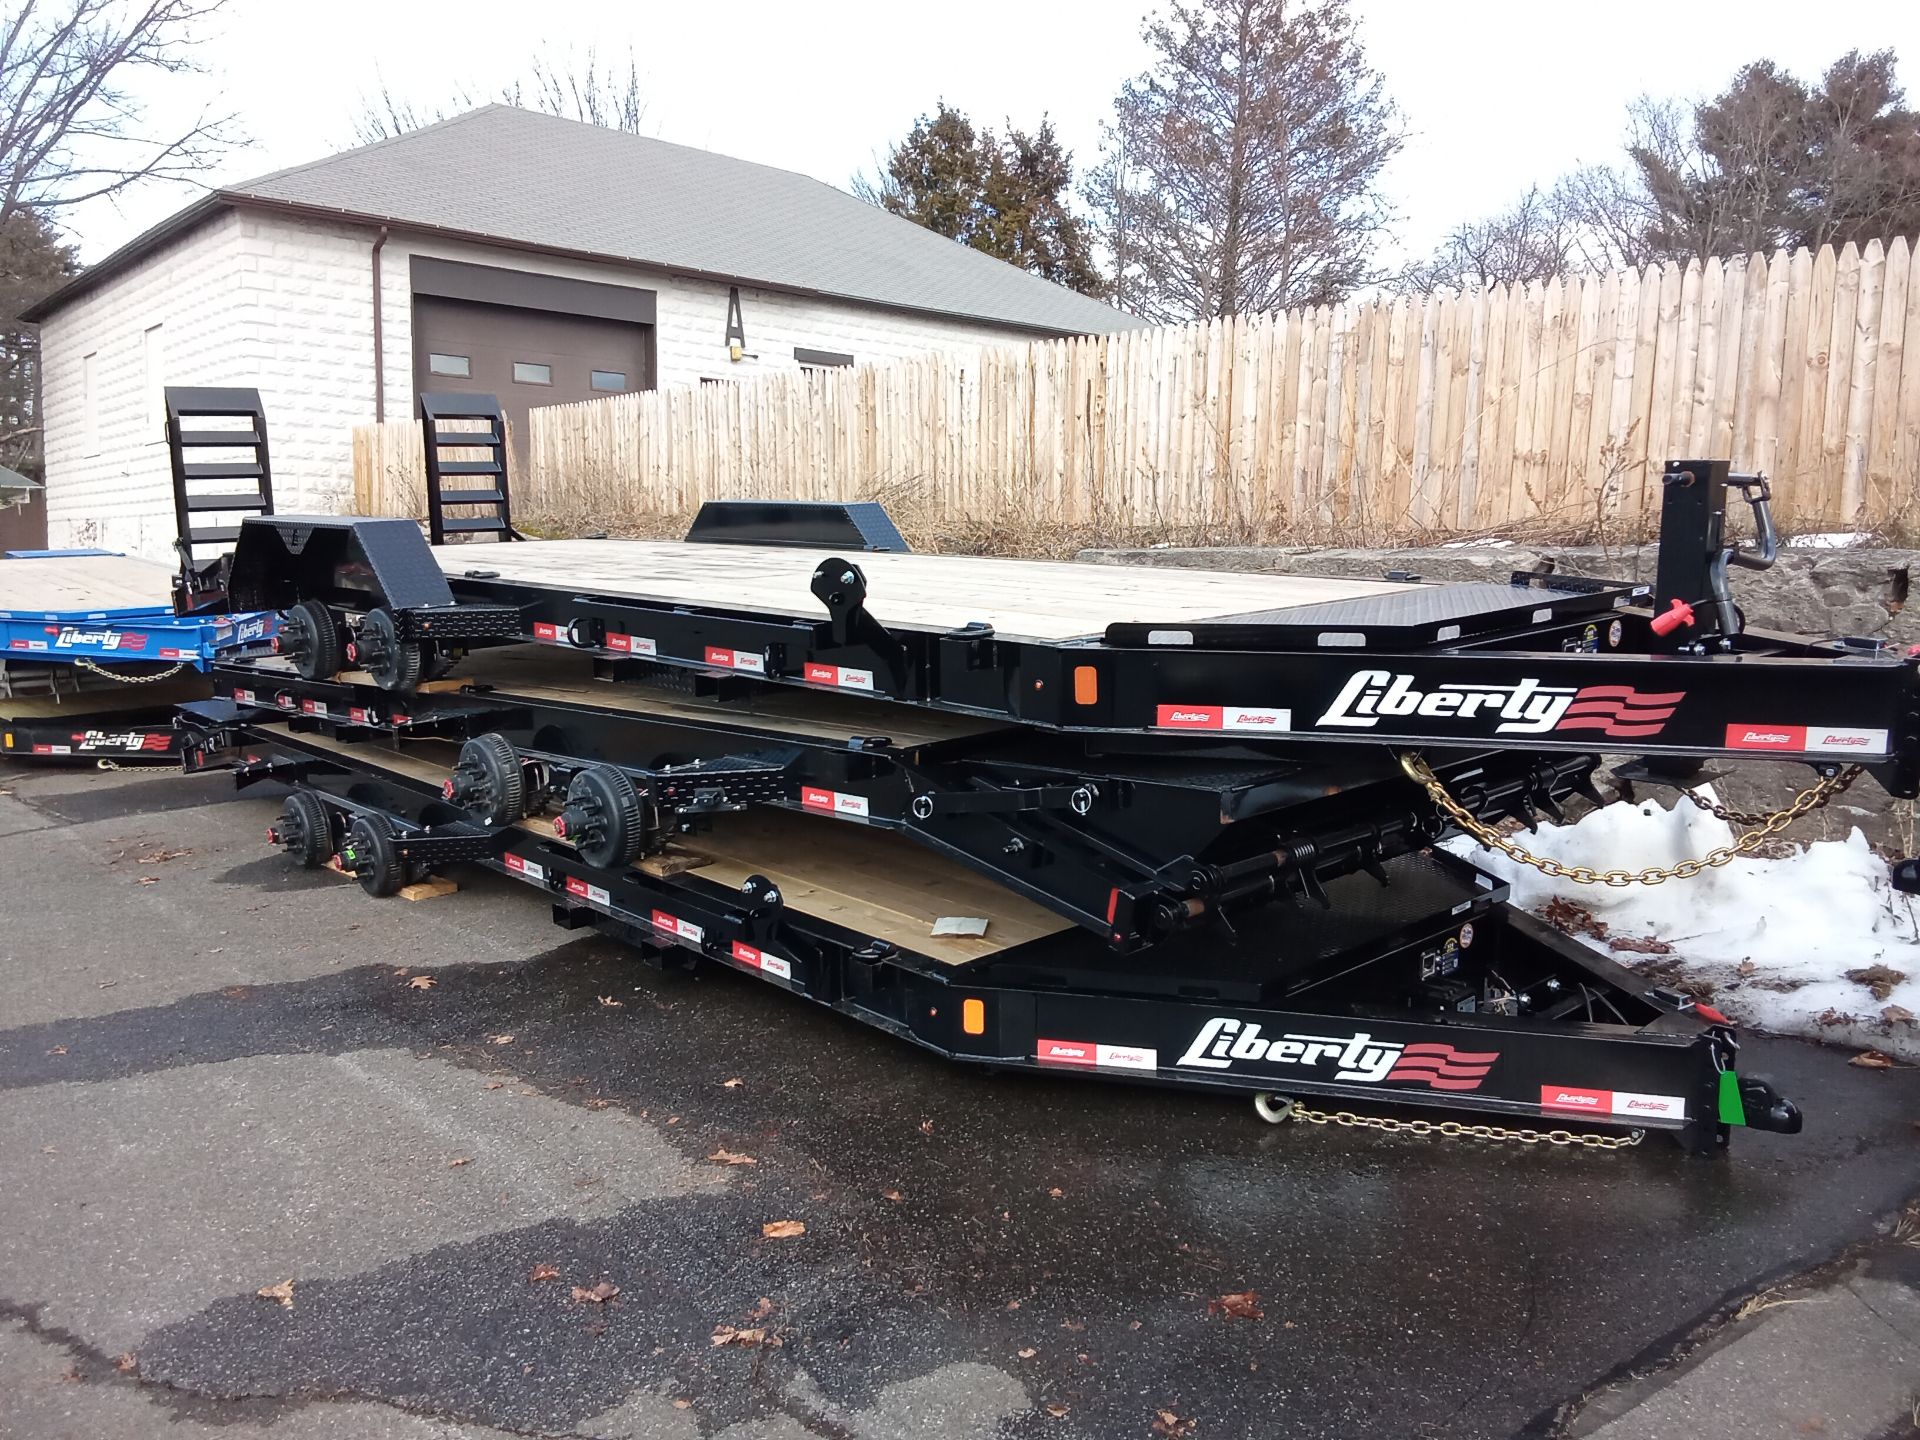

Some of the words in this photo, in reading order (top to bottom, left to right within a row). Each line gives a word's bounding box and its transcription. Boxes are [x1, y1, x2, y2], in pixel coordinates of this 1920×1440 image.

[55, 626, 122, 650] Liberty
[236, 619, 265, 644] Liberty
[1314, 670, 1578, 734] Liberty
[1236, 714, 1266, 724] Liberty
[79, 729, 145, 751] Liberty
[1822, 735, 1856, 747] Liberty
[1176, 1017, 1405, 1082] Liberty
